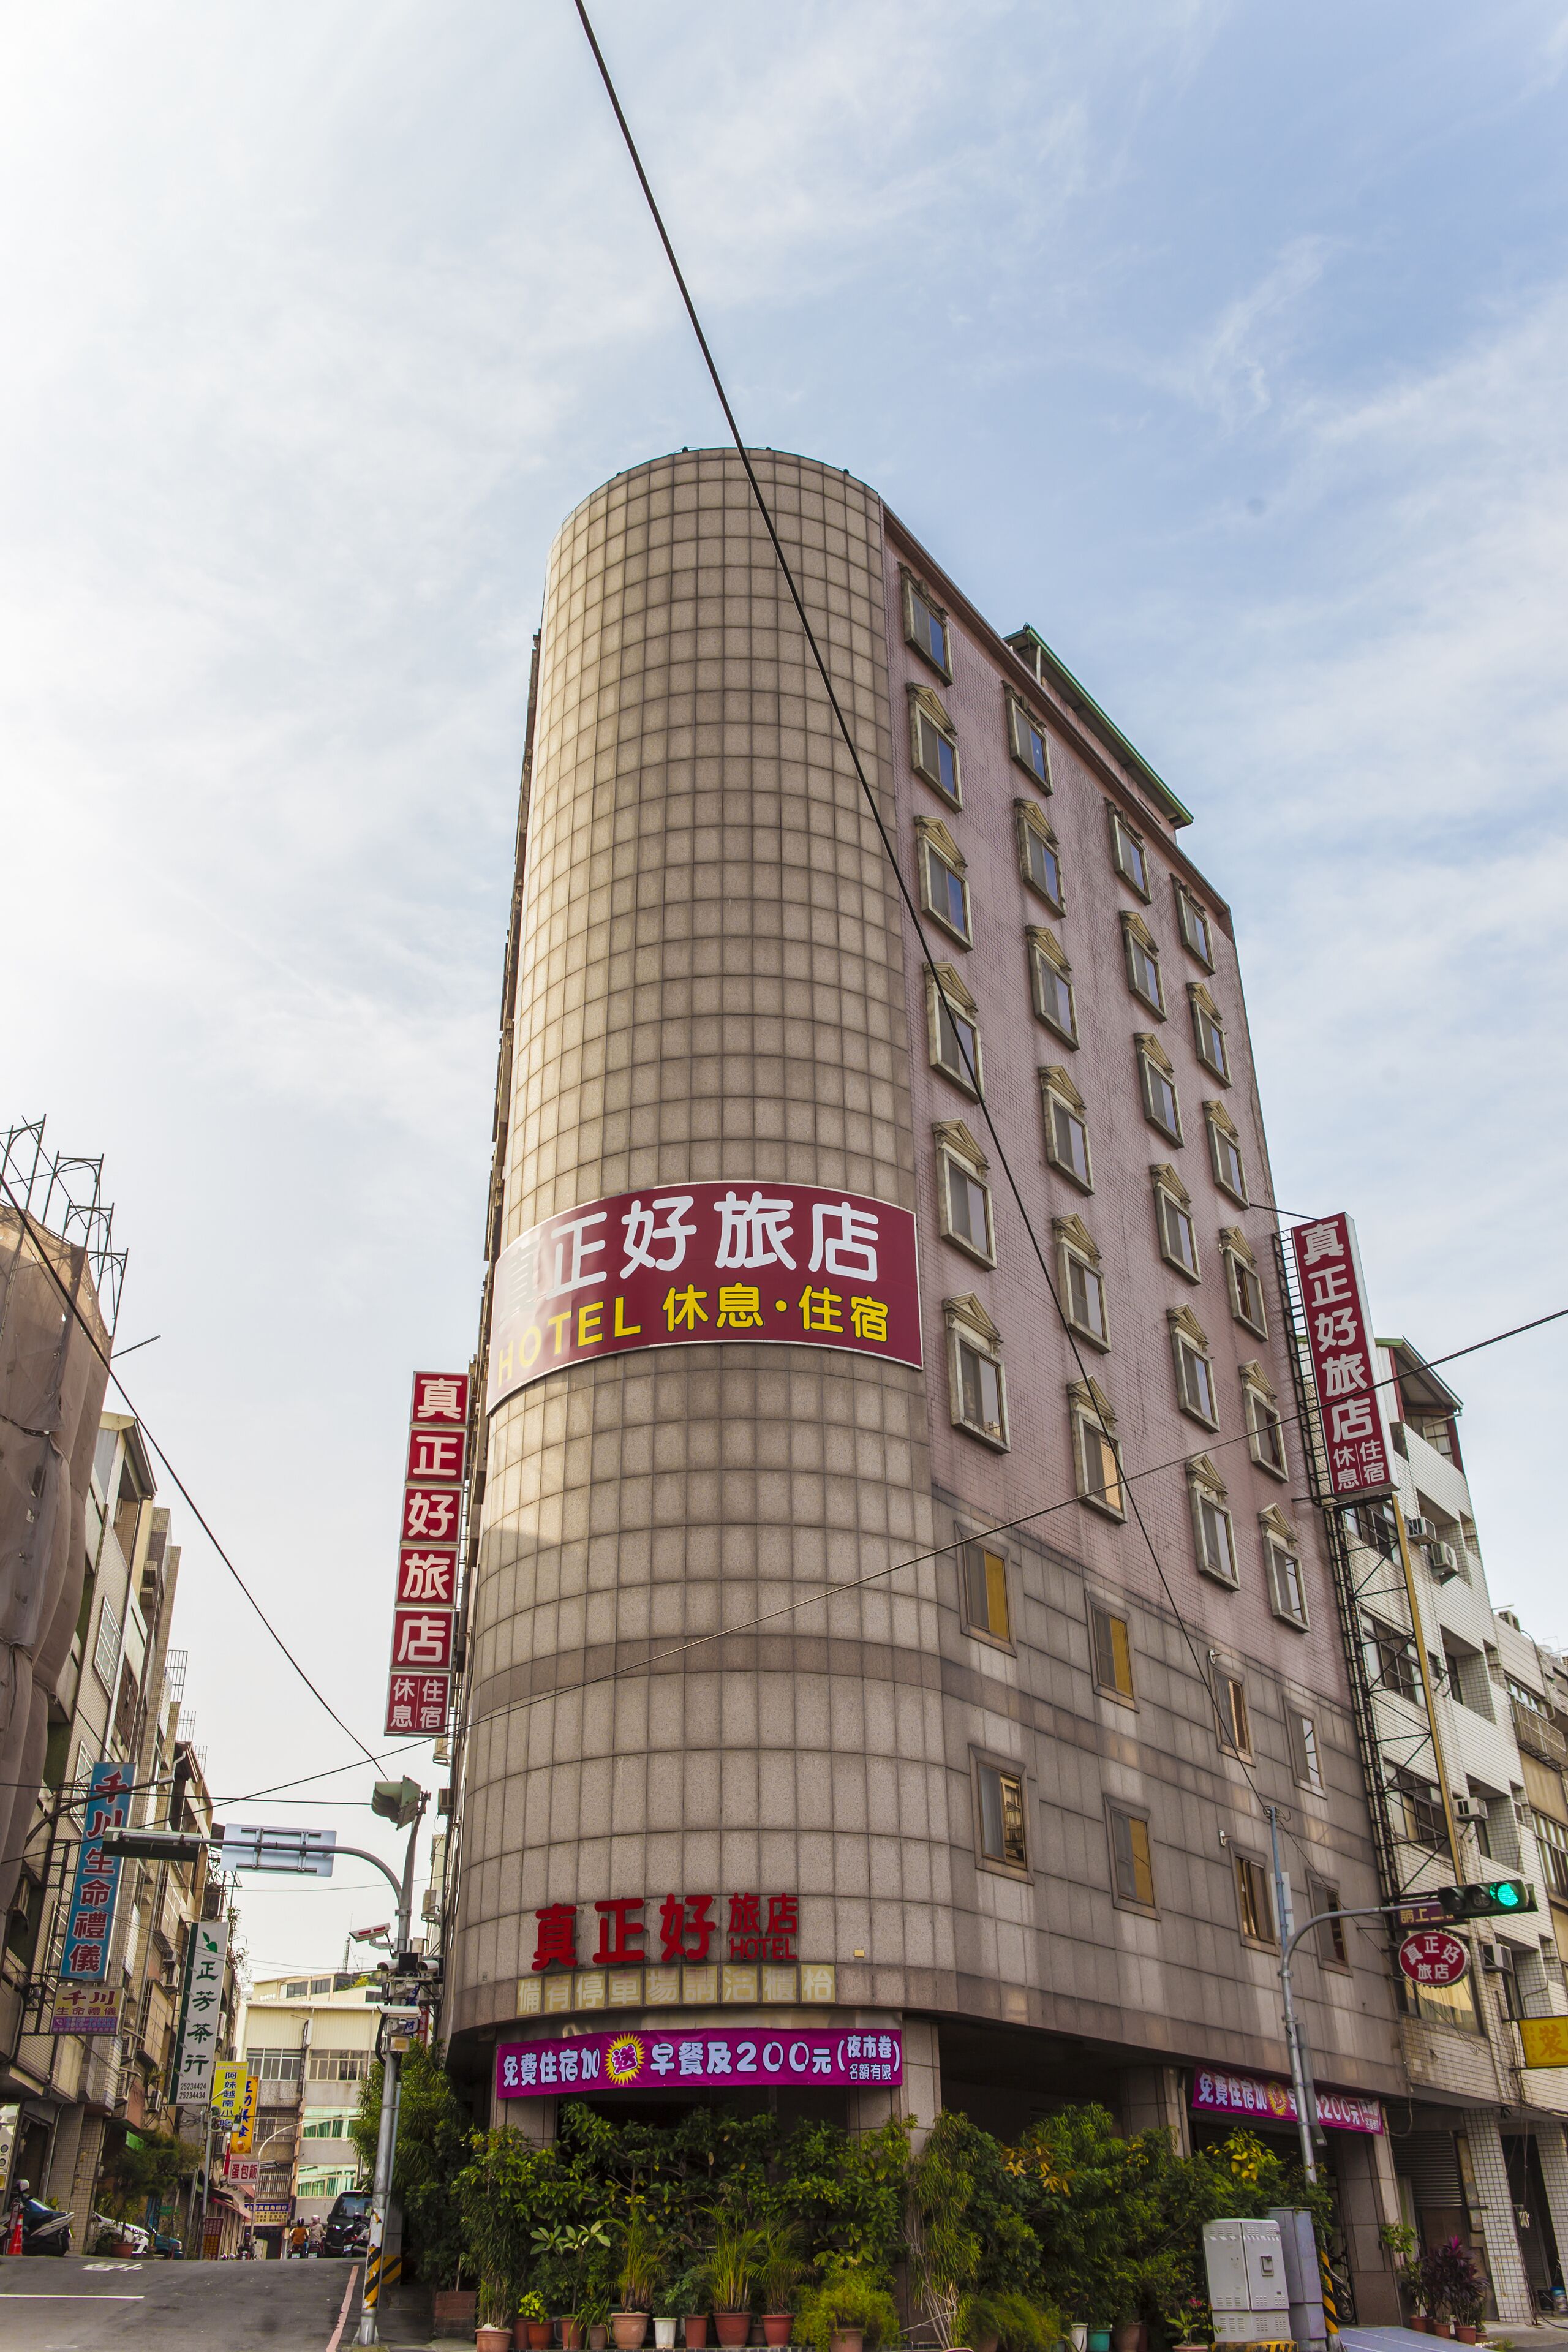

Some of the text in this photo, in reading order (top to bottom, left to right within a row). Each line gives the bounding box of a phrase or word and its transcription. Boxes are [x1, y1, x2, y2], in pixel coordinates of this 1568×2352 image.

[499, 1191, 880, 1323] 真正好旅店
[497, 1296, 642, 1388] HOTEL
[1301, 1221, 1374, 1444] 真正好旅店
[1333, 1446, 1360, 1491] 休息
[1360, 1439, 1385, 1485] 住宿
[397, 1378, 462, 1663] 真正好旅店
[390, 1678, 415, 1728] 休息
[419, 1678, 444, 1729] 住宿
[69, 1770, 129, 1972] 千川生命禮儀
[730, 1937, 797, 1959] HOTEL
[56, 2007, 116, 2016] 生命禮儀
[62, 1989, 115, 2006] 千川
[184, 1961, 219, 2076] 正芳茶行
[849, 2063, 892, 2081] 名額有限
[231, 2163, 258, 2179] 蛋包飯
